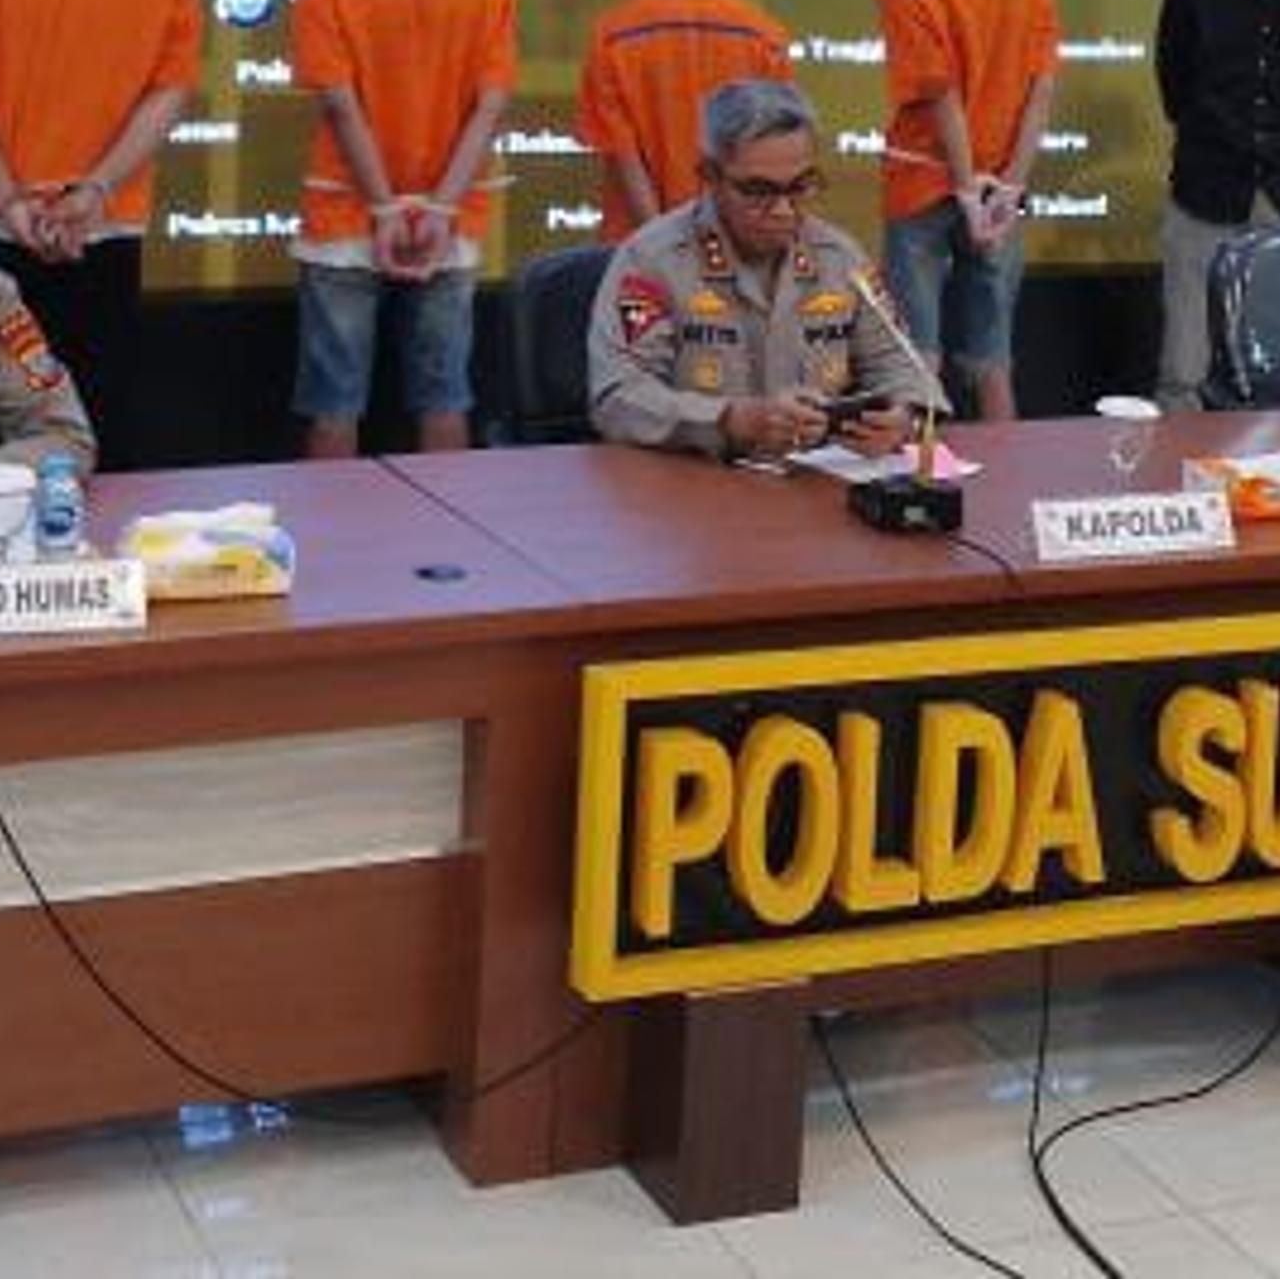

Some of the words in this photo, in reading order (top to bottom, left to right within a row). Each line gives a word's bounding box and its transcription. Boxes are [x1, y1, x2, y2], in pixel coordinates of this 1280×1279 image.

[1066, 504, 1206, 543] KAPOLDA
[16, 576, 112, 614] HUMAS
[630, 689, 1104, 938] POLDA
